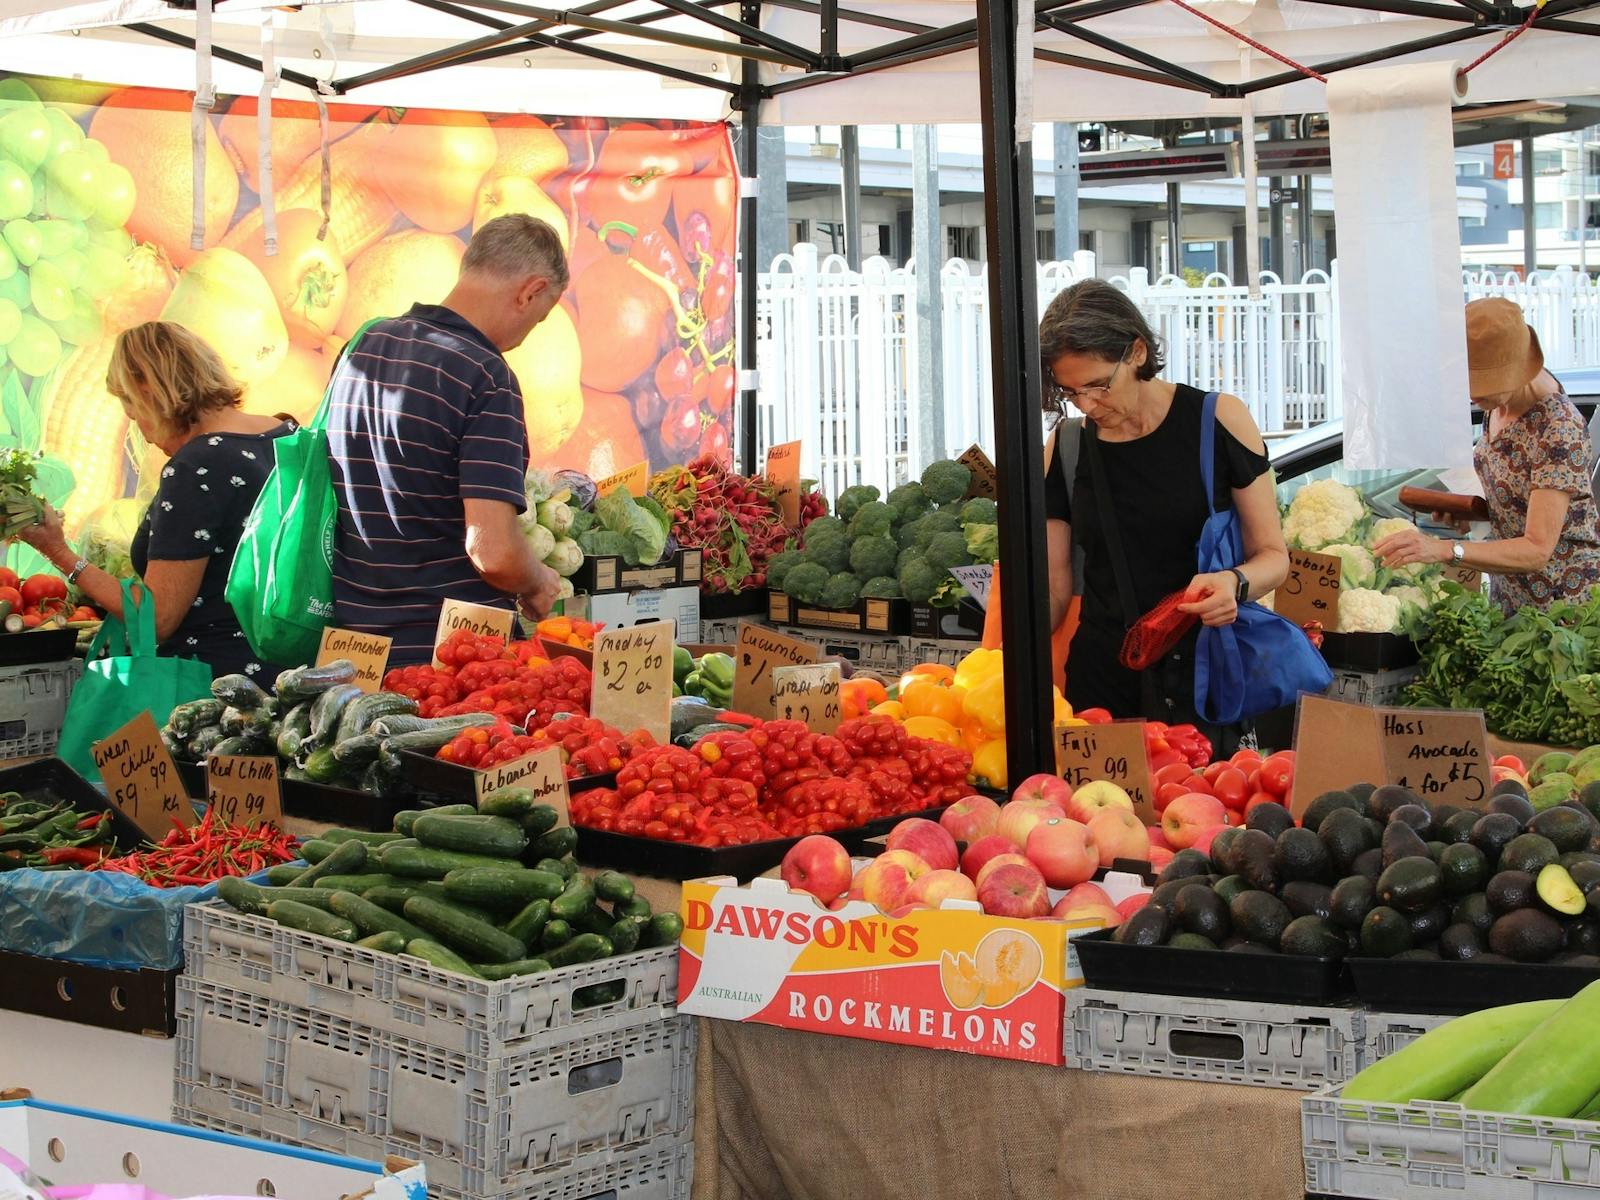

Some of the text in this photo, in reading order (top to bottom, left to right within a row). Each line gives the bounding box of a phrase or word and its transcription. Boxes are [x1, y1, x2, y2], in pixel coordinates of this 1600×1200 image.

[1498, 154, 1512, 176] 4
[1457, 569, 1476, 584] 50
[356, 664, 380, 681] mber
[1384, 715, 1424, 736] Hass
[95, 739, 130, 768] Green
[1061, 730, 1097, 758] Fuji
[121, 744, 157, 778] Chilli
[210, 757, 275, 781] Red Chilli
[533, 775, 562, 798] mber
[1421, 772, 1448, 794] for
[1448, 762, 1485, 802] $5
[685, 899, 920, 959] DAWSON'S
[699, 985, 764, 1004] AUSTRALIAN
[788, 991, 1038, 1050] ROCKMELONS
